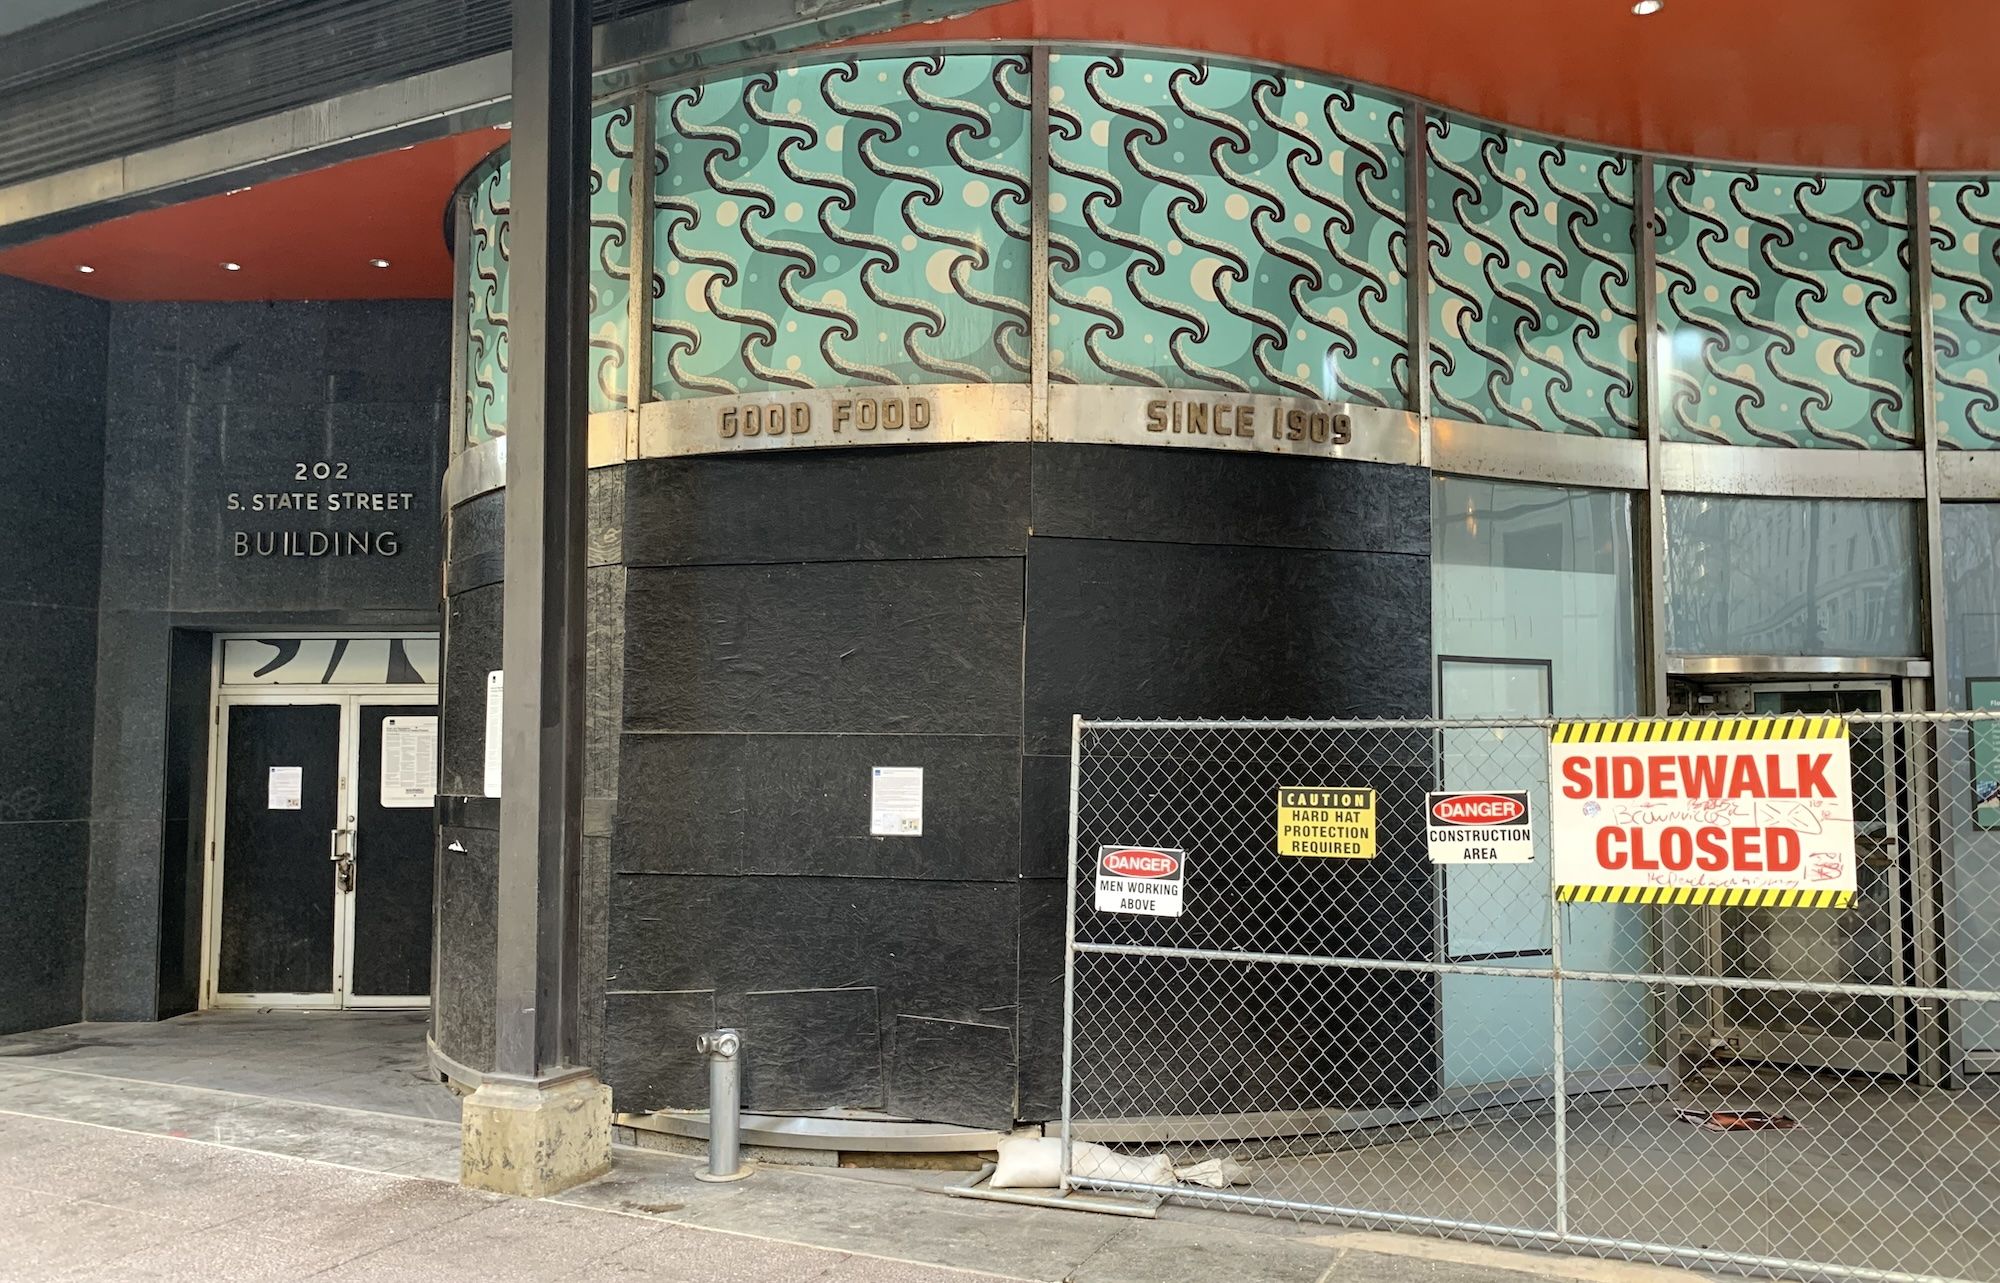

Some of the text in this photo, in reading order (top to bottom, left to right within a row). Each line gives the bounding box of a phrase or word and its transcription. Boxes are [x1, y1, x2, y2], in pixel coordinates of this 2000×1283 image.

[717, 397, 931, 438] GOOD FOOD
[1147, 400, 1352, 444] SINCE 1909
[295, 462, 349, 481] 202
[227, 492, 413, 511] S. STATE STREET
[234, 531, 398, 557] BUILDING
[1562, 753, 1837, 800] SIDEWALK
[1287, 793, 1364, 807] CAUTION
[1292, 810, 1361, 823] HARD HAT
[1440, 802, 1516, 818] DANGER
[1284, 825, 1369, 839] PROTECTION
[1429, 829, 1531, 842] CONSTRUCTION
[1292, 841, 1361, 855] REQUIRED
[1463, 847, 1498, 860] AREA
[1596, 826, 1801, 873] CLOSED
[1109, 855, 1171, 872] DANGER
[1099, 880, 1179, 896] MEN WORKING
[1120, 898, 1157, 911] ABOVE
